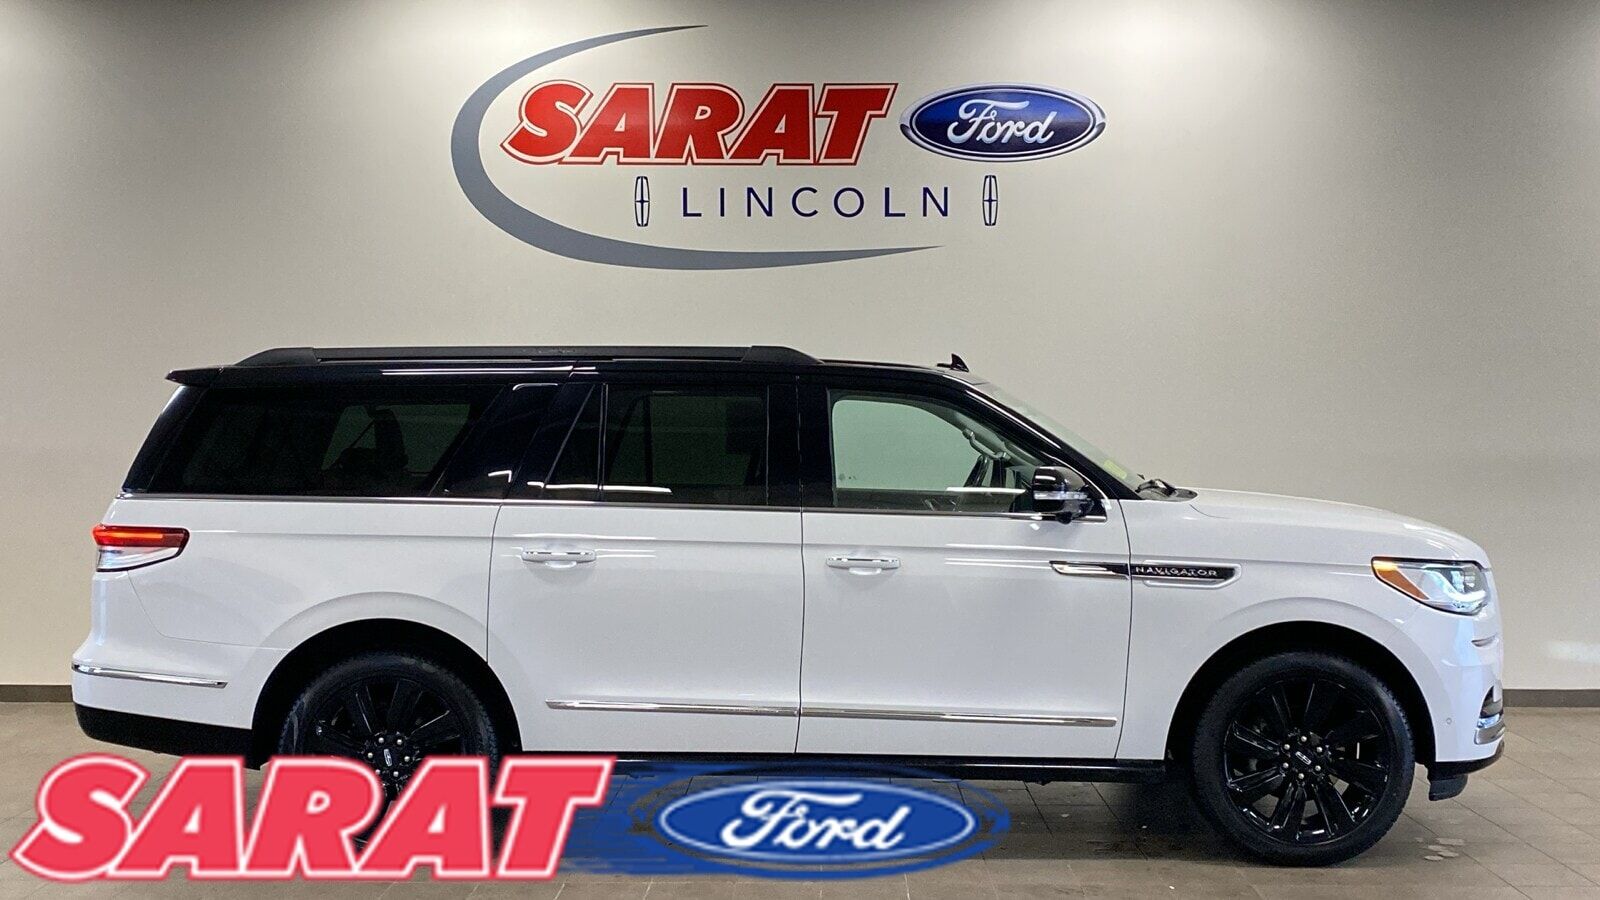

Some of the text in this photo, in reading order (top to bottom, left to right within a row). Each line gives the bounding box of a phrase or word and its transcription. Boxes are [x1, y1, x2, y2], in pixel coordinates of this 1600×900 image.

[499, 80, 1057, 166] SARAT Ford
[682, 186, 950, 218] LINCOLN
[1135, 566, 1218, 577] NAVIGATOR
